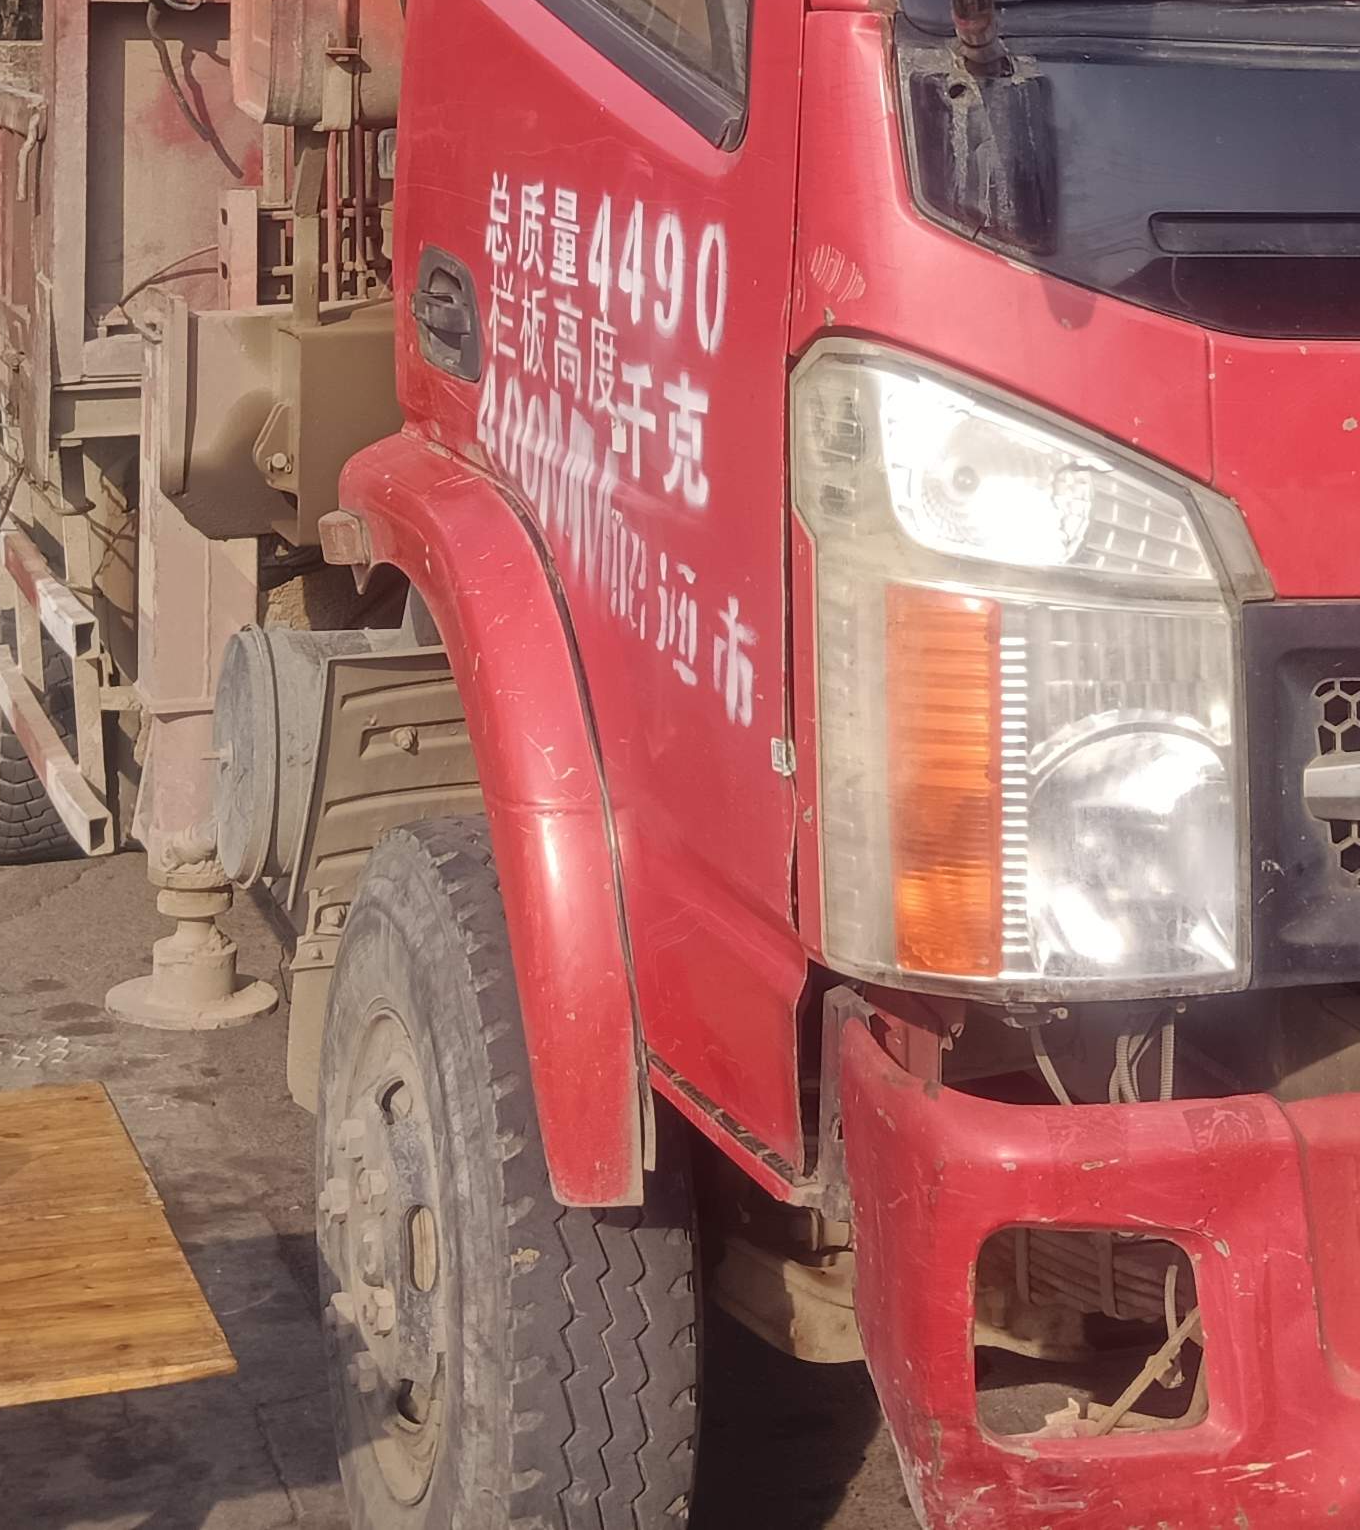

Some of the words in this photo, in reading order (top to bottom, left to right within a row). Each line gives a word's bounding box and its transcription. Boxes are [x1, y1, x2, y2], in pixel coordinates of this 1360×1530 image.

[488, 262, 618, 416] 栏板高度
[617, 363, 709, 508] 千克
